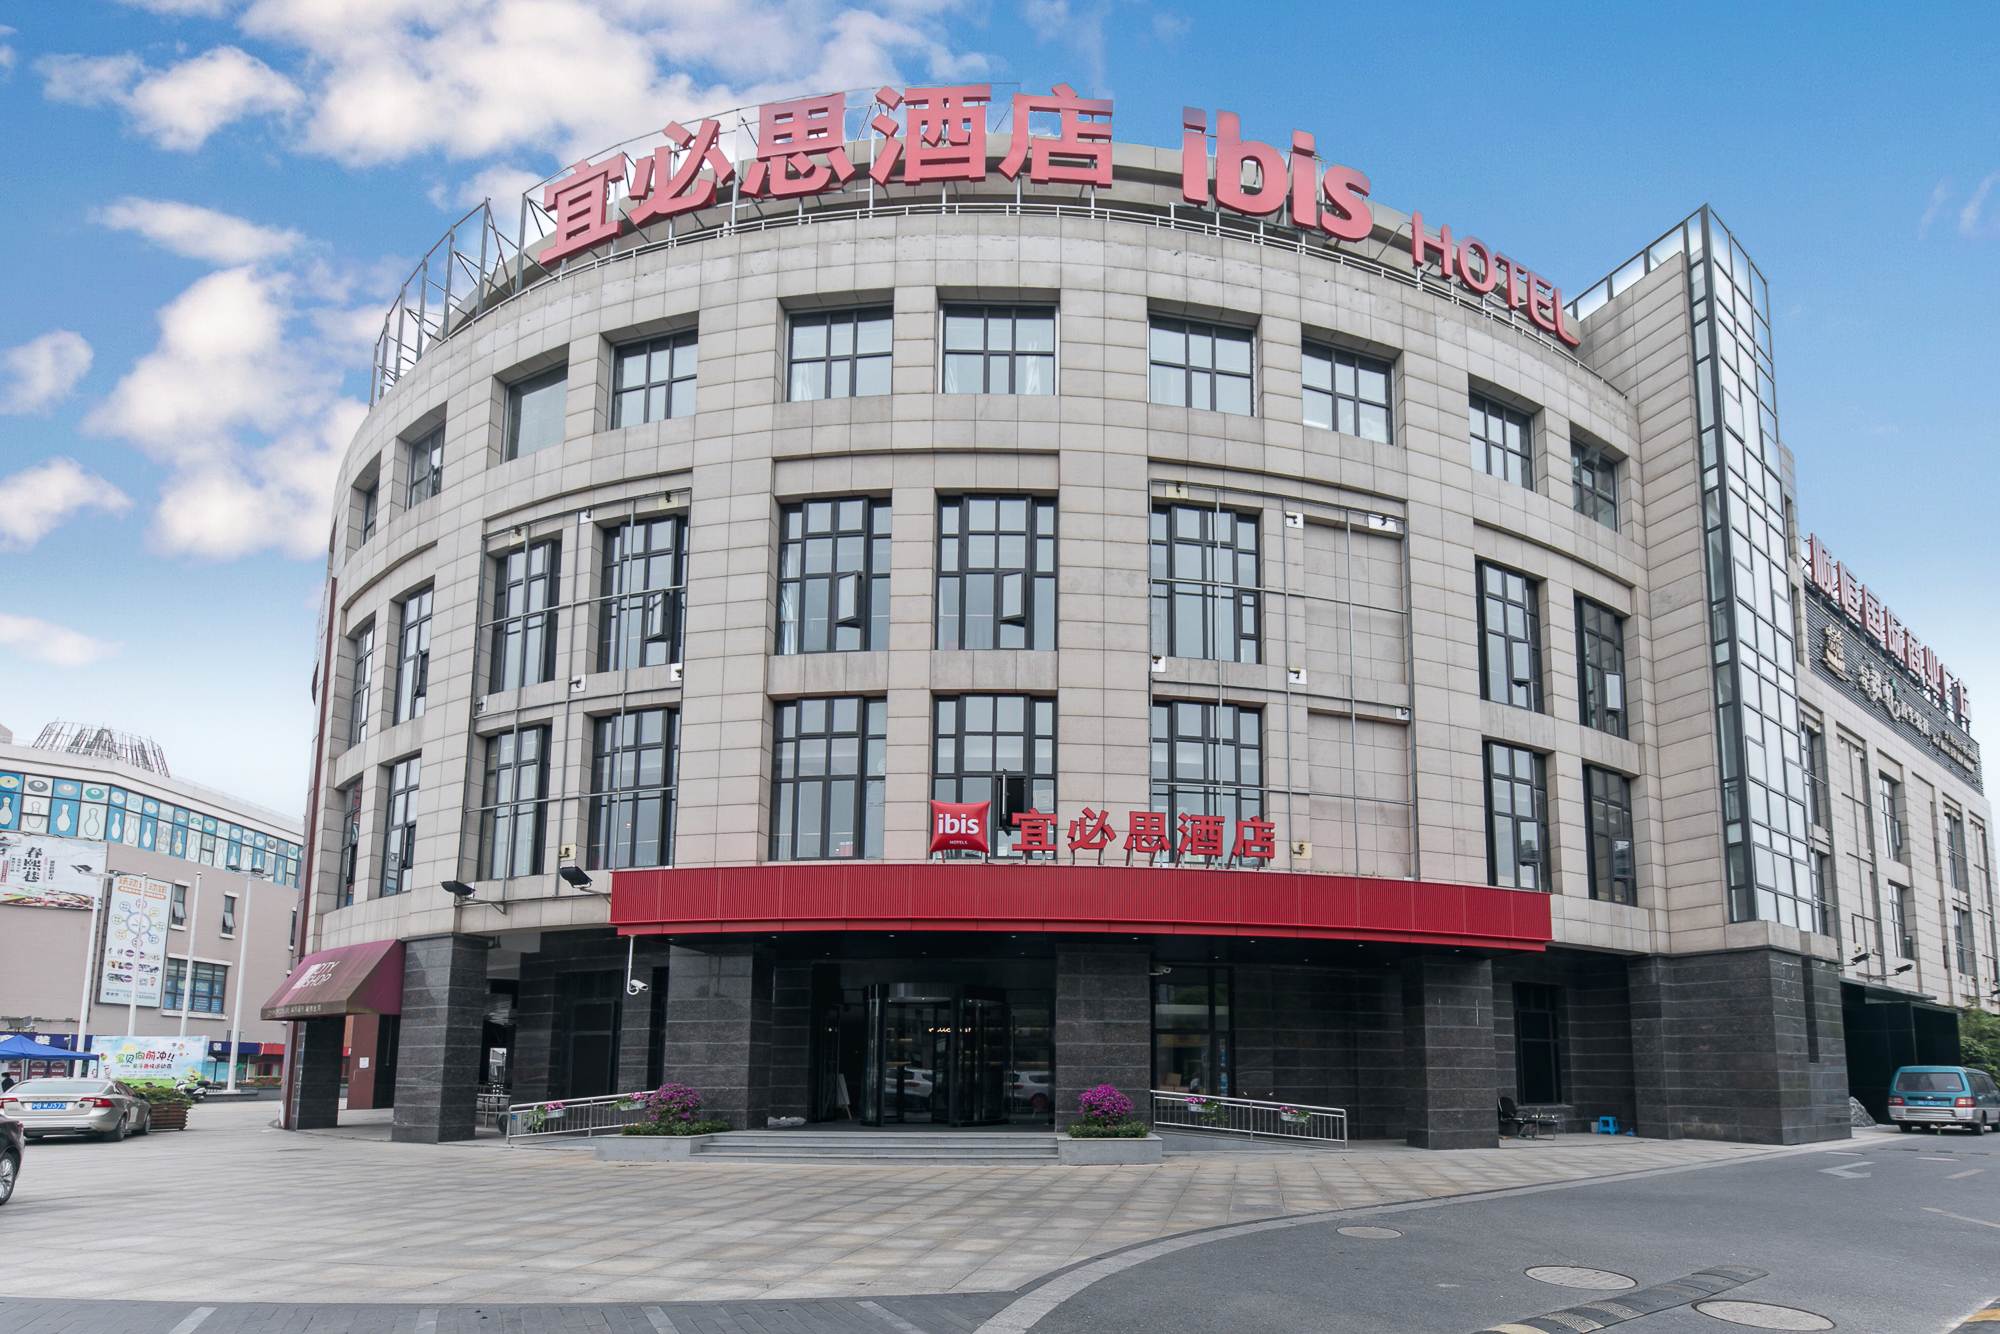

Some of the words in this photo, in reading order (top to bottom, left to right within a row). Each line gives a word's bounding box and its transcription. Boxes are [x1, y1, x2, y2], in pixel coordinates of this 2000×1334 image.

[539, 84, 1114, 264] 宜必思酒店
[1182, 106, 1373, 242] ibis
[1411, 210, 1581, 348] HOTEL
[938, 813, 979, 834] ibis
[1012, 807, 1275, 859] 宜必思酒店
